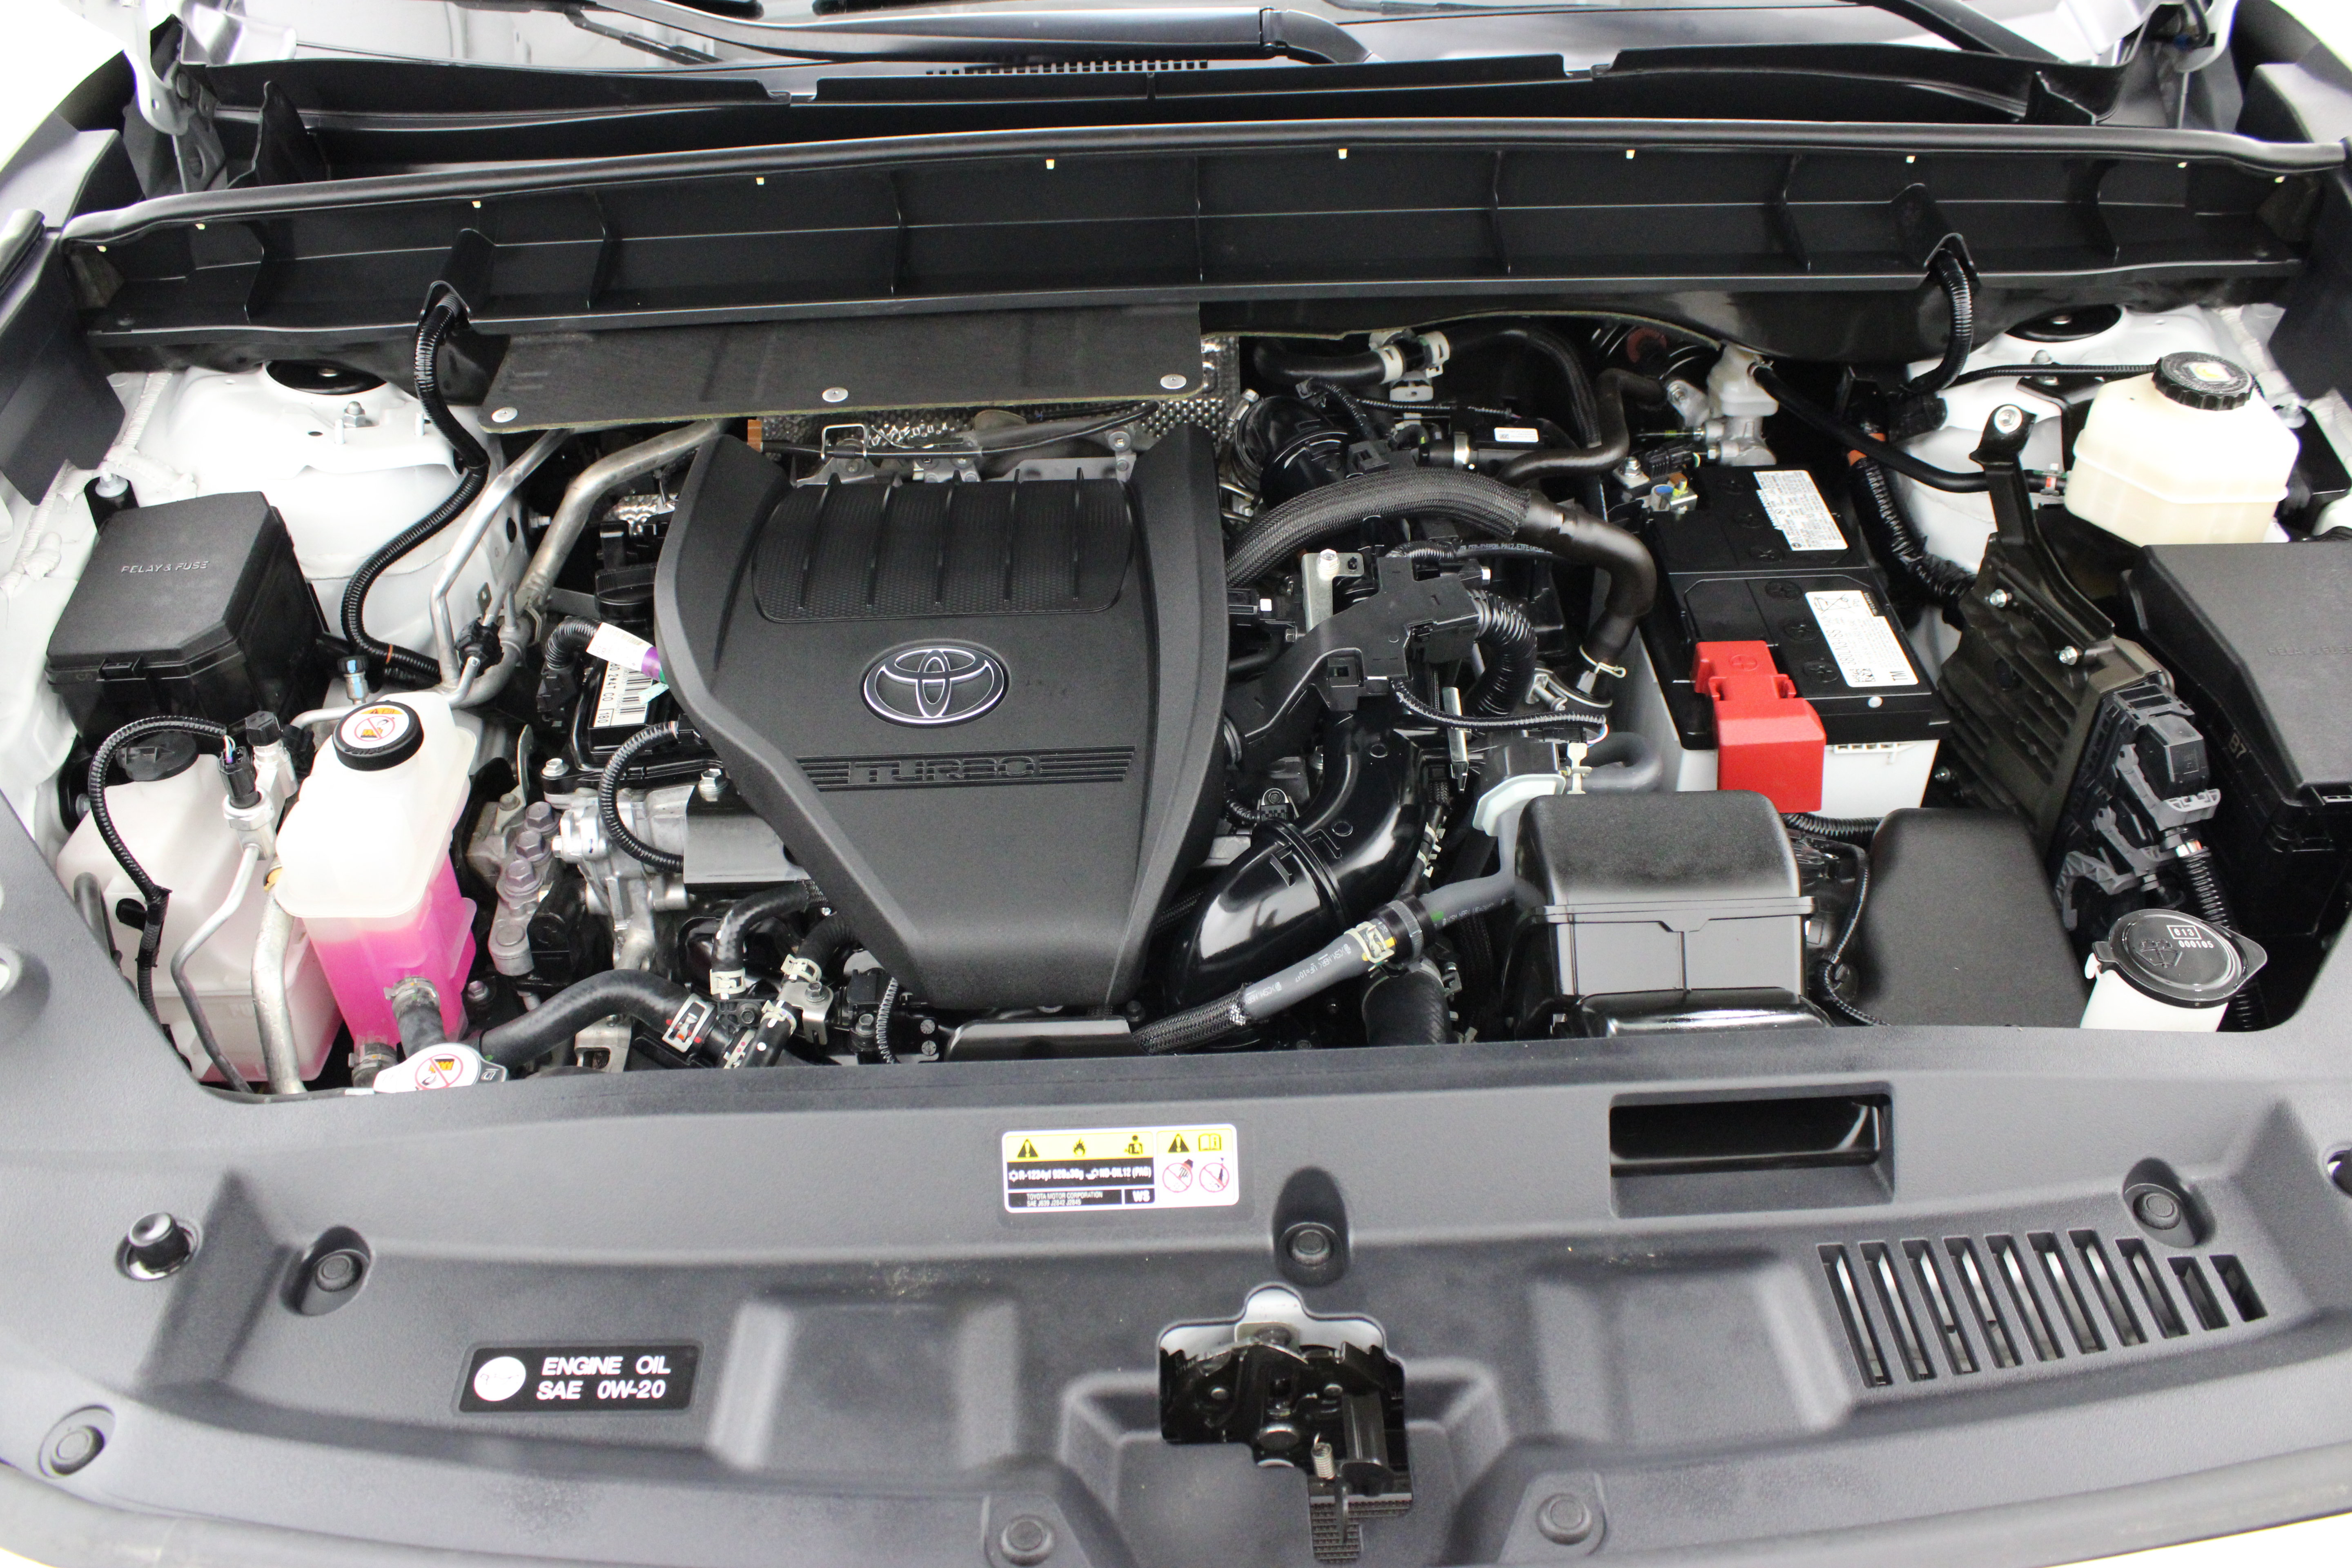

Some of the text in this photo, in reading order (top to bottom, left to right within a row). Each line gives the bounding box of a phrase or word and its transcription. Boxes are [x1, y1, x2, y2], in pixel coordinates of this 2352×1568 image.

[121, 564, 162, 574] RELAY
[174, 561, 210, 571] FUSE
[1889, 670, 1909, 682] TM
[597, 712, 610, 724] 180
[854, 755, 1035, 783] TURBO
[2178, 939, 2214, 949] 000105
[1027, 1191, 1103, 1200] TOYOTA MOTOR CORPORATION
[1132, 1190, 1150, 1202] WS
[541, 1355, 671, 1376] ENGINE OIL
[536, 1379, 666, 1400] SAE 0W-20
